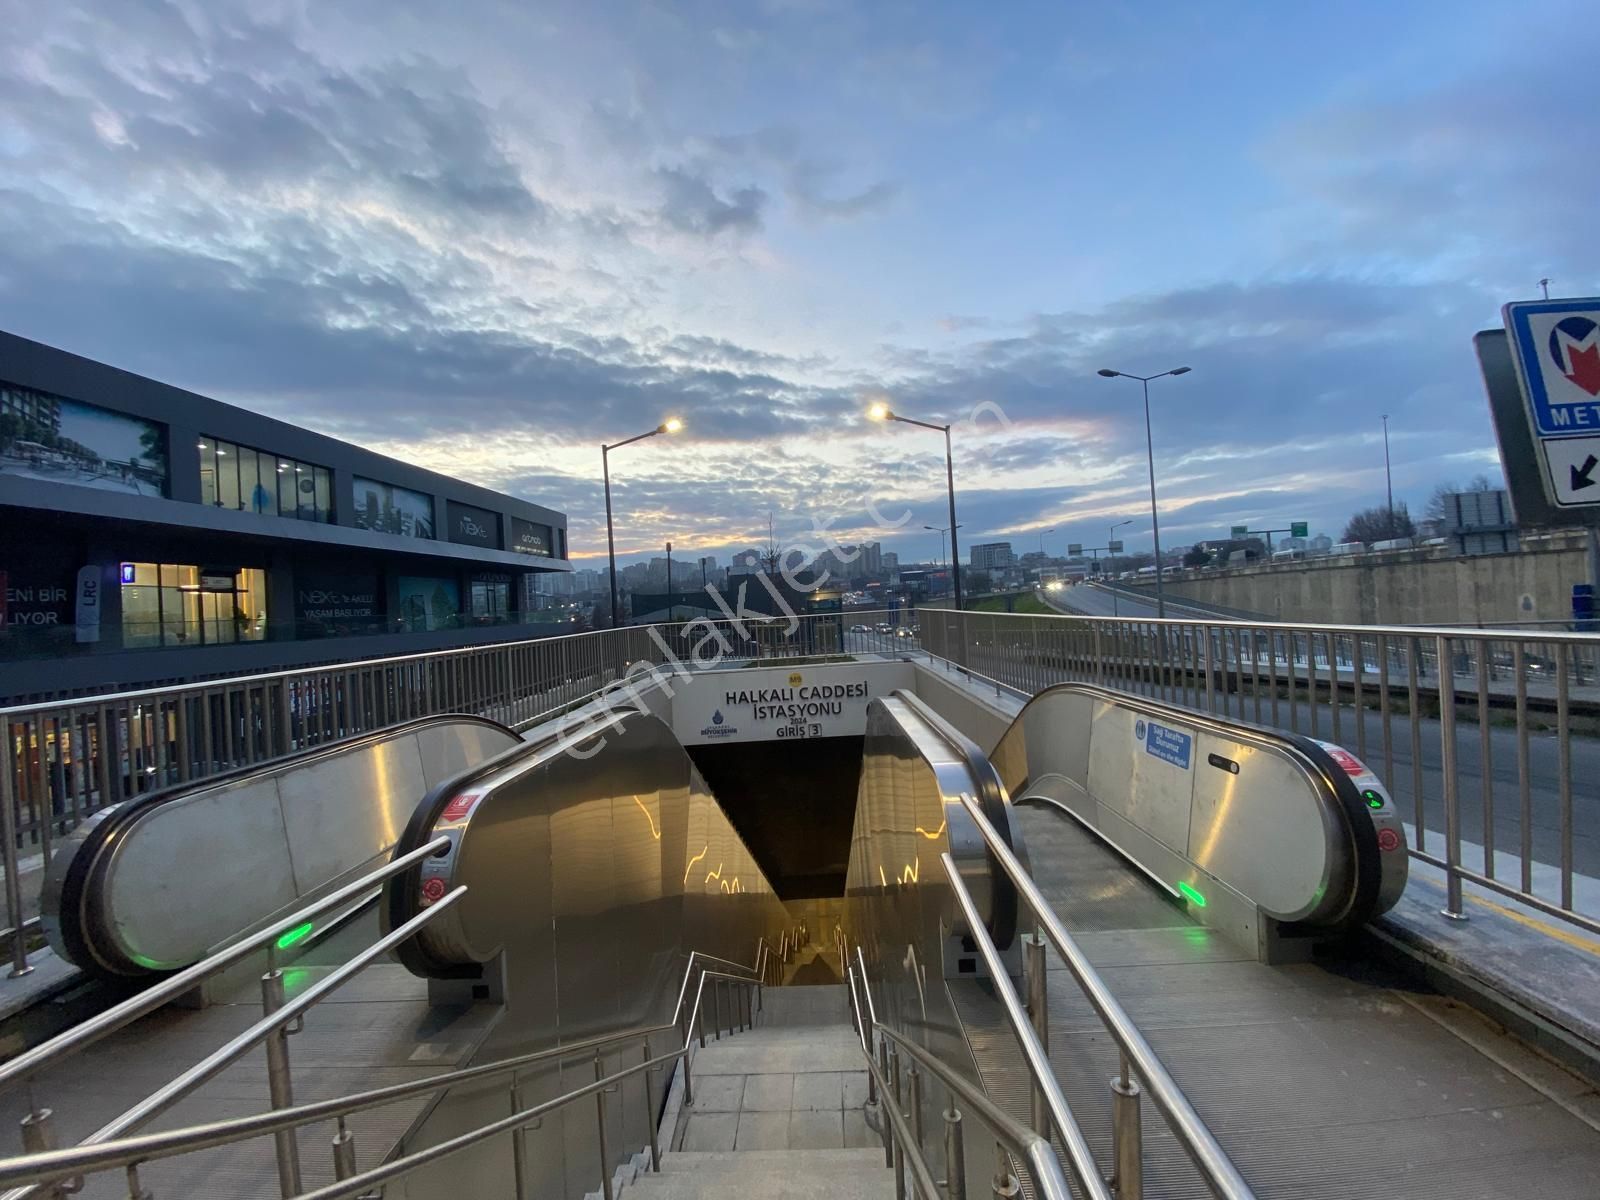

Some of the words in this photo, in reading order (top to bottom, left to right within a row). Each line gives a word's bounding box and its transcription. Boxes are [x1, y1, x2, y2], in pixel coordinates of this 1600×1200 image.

[6, 586, 33, 602] ENİ
[39, 586, 68, 602] BİR
[83, 580, 97, 607] LRC
[6, 612, 58, 625] LIYOR
[726, 687, 794, 705] HALKALI
[799, 680, 869, 699] CADDESİ
[753, 701, 842, 720] İSTASYONU
[776, 724, 806, 738] GİRİŞ
